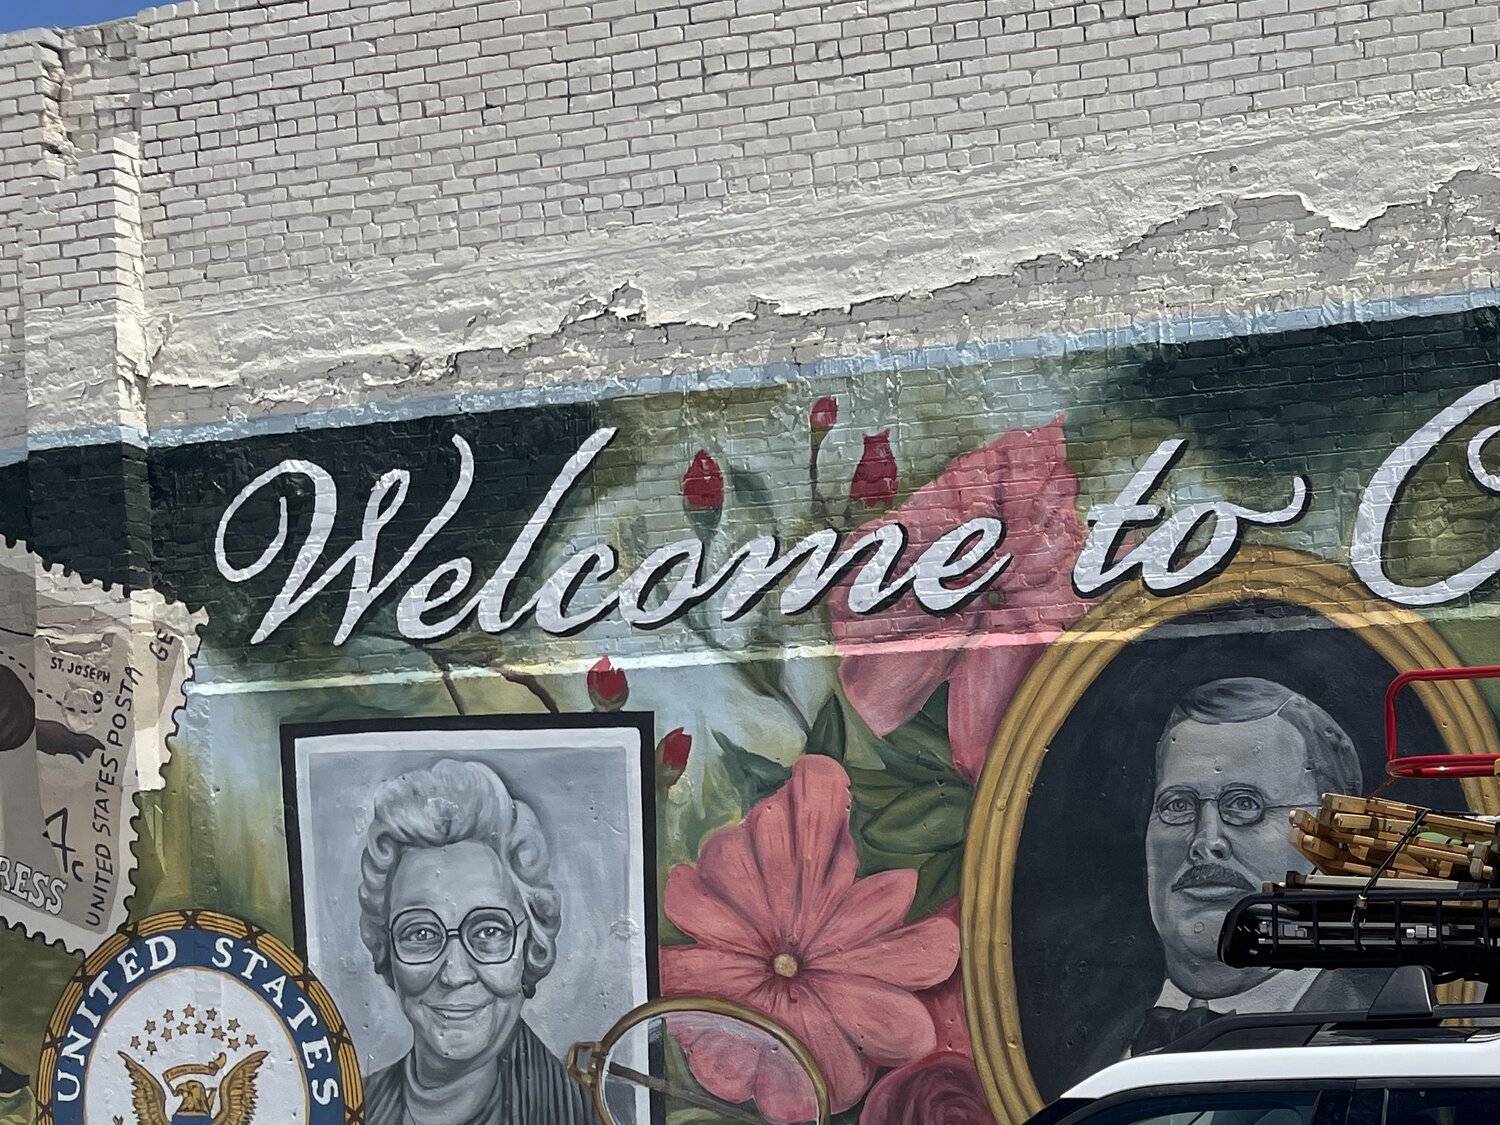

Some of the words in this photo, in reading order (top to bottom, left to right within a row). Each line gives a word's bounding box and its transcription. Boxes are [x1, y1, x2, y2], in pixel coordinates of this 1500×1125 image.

[214, 426, 1014, 646] Welcome
[1071, 436, 1308, 598] to
[50, 656, 66, 672] ST.
[67, 661, 112, 684] JOSEPH
[91, 748, 119, 840] STATES
[85, 843, 113, 927] UNITED
[57, 935, 178, 1103] UNITED
[210, 937, 340, 1107] STATES
